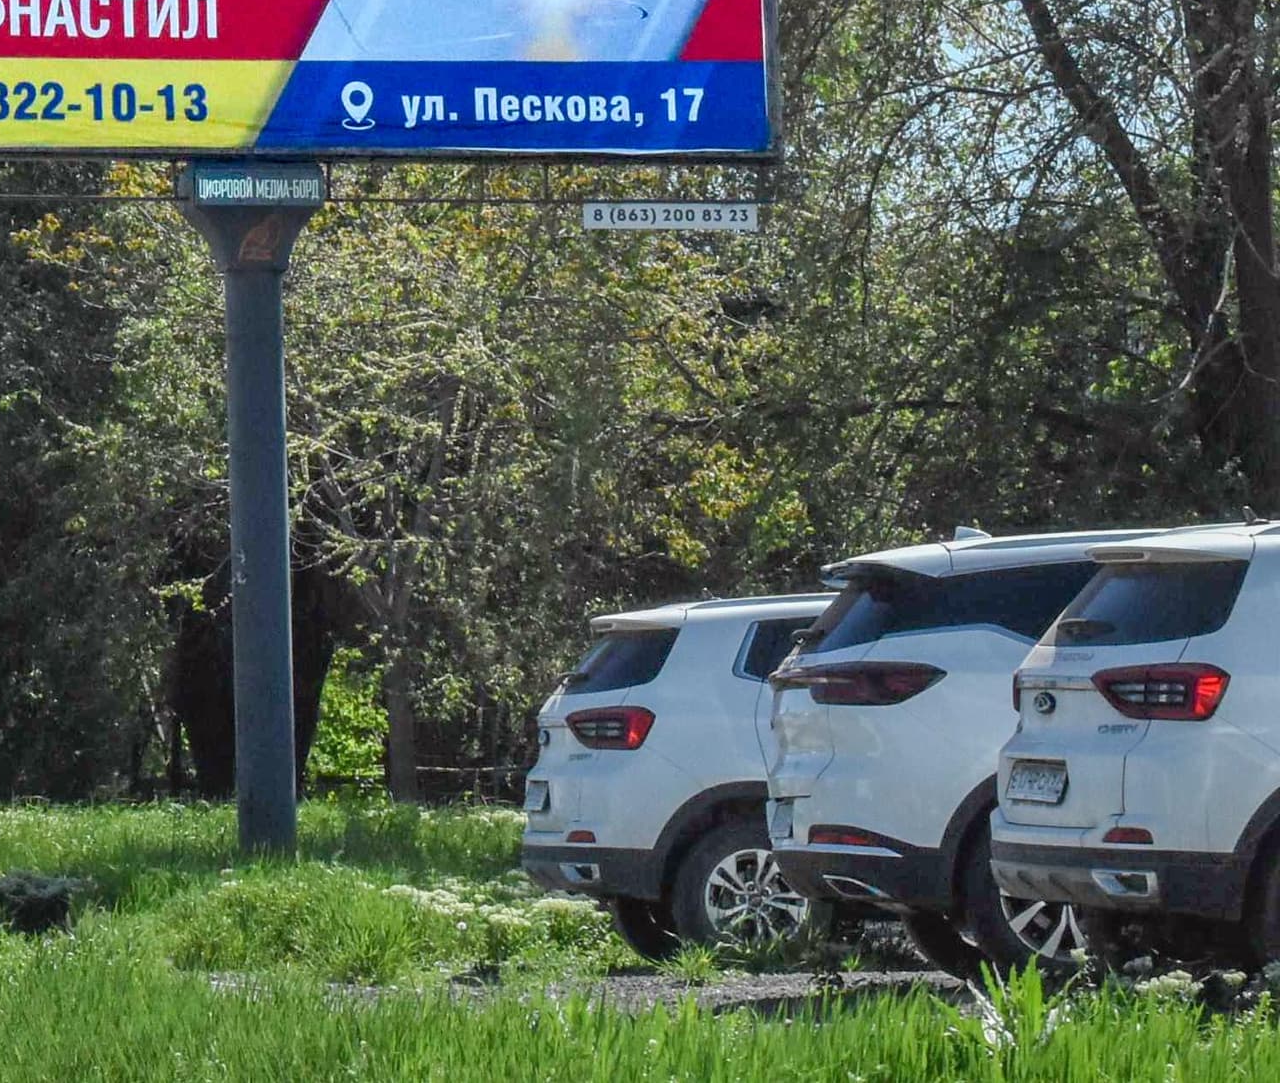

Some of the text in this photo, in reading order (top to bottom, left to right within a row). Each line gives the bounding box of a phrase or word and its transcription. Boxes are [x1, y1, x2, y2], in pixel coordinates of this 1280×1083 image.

[401, 86, 704, 129] ул. Пескова, 17
[198, 176, 320, 201] ЦИФРОВОЙ МЕДИА-БОРД
[593, 206, 749, 225] 8 (863) 200 83 23
